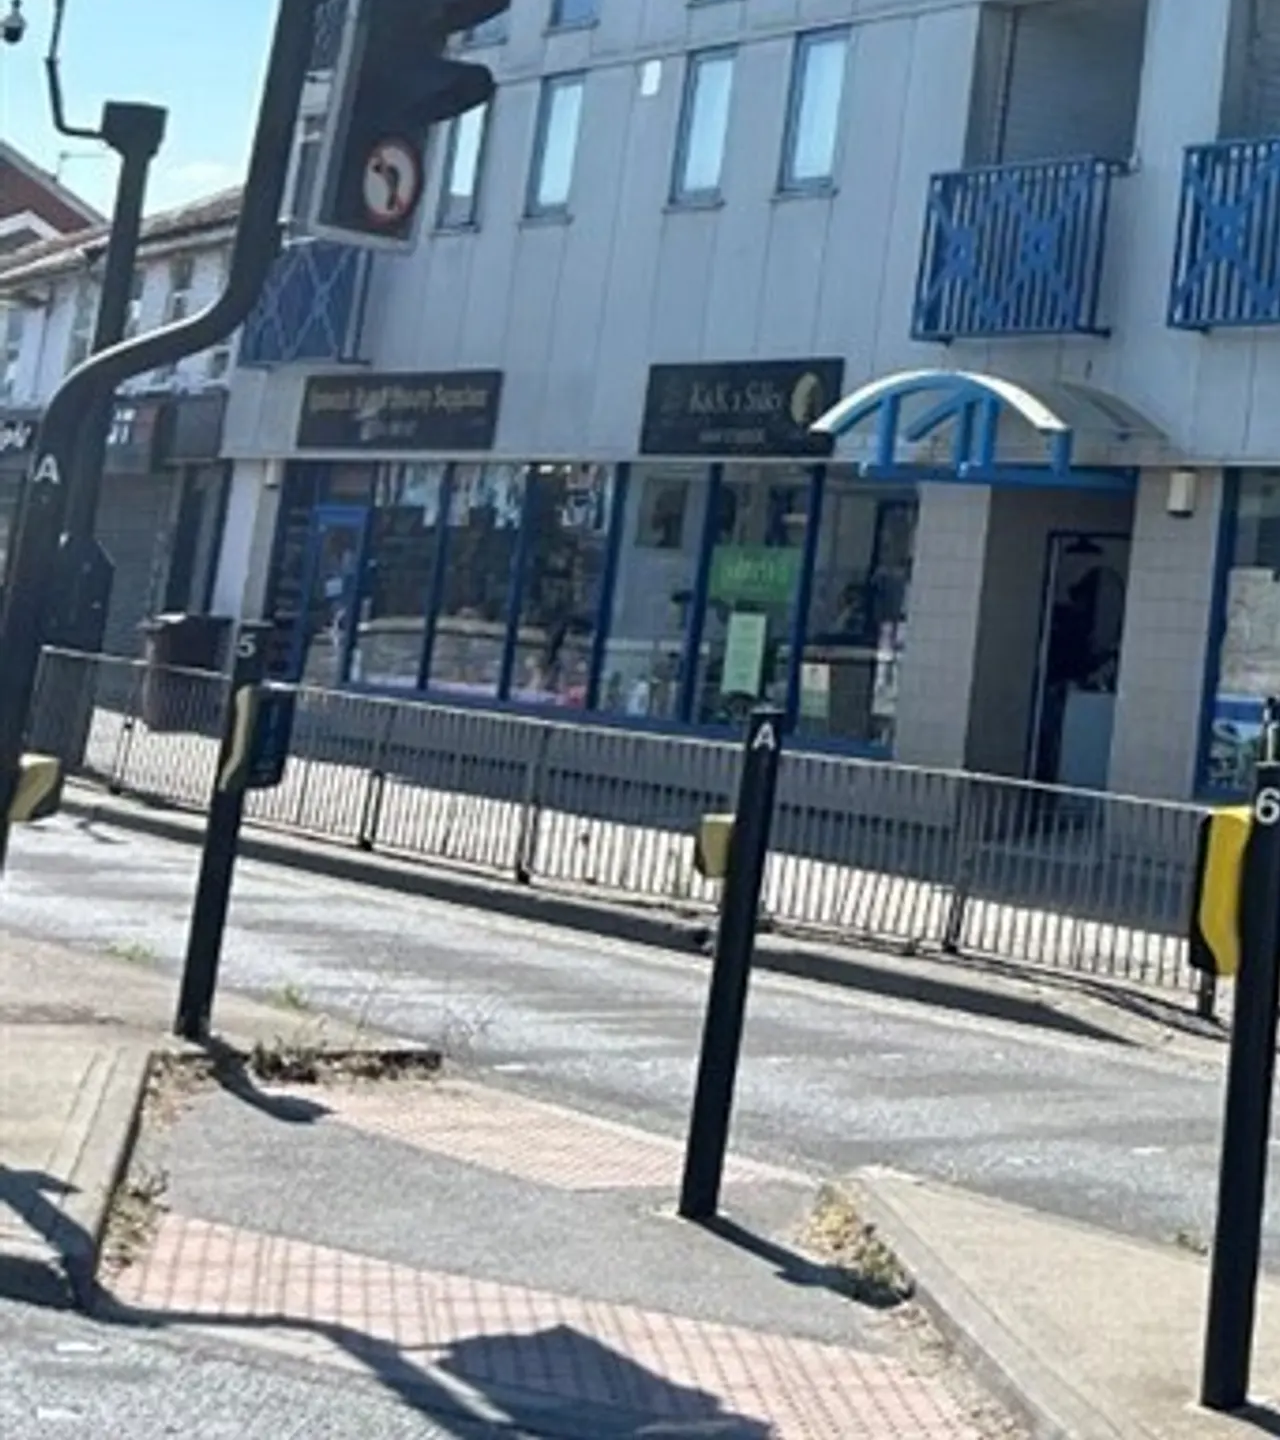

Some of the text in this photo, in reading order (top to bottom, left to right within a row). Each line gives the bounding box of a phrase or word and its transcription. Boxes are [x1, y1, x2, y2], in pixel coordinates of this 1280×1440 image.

[33, 453, 61, 484] A
[236, 632, 257, 658] 5
[751, 720, 777, 751] A
